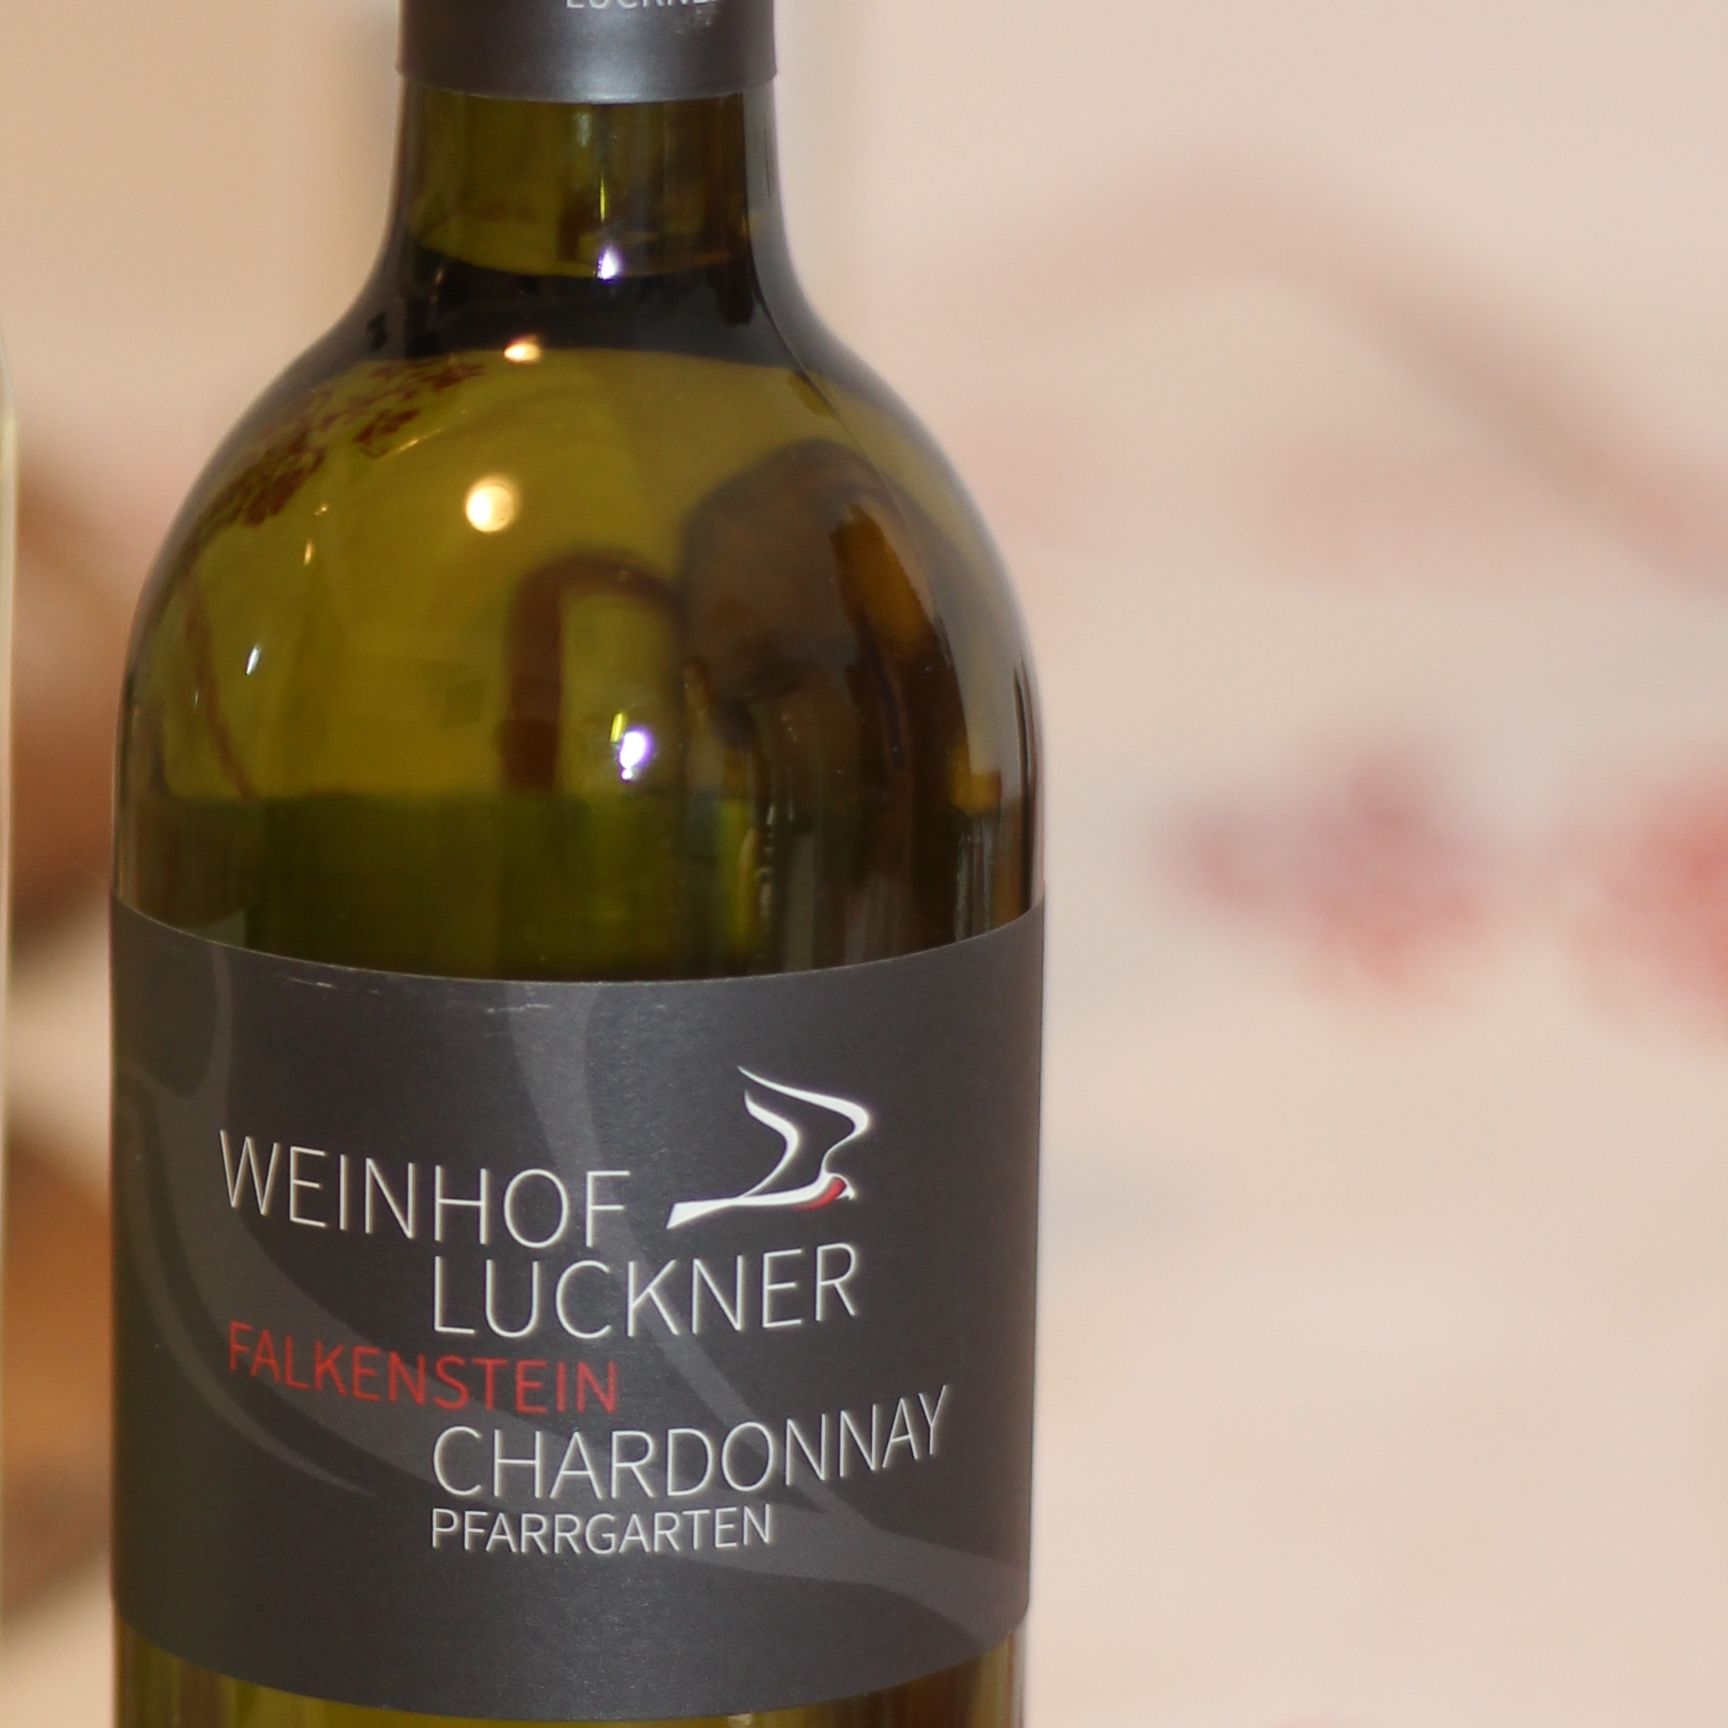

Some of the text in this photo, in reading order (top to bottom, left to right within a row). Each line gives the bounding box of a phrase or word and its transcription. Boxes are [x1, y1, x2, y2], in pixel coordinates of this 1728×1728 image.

[218, 1128, 632, 1249] WEINHOF
[432, 1242, 860, 1340] LUCKNER
[227, 1320, 619, 1414] FALKENSTEIN
[432, 1383, 950, 1501] CHARDONNAY
[430, 1502, 774, 1555] PFARRGARTEN
